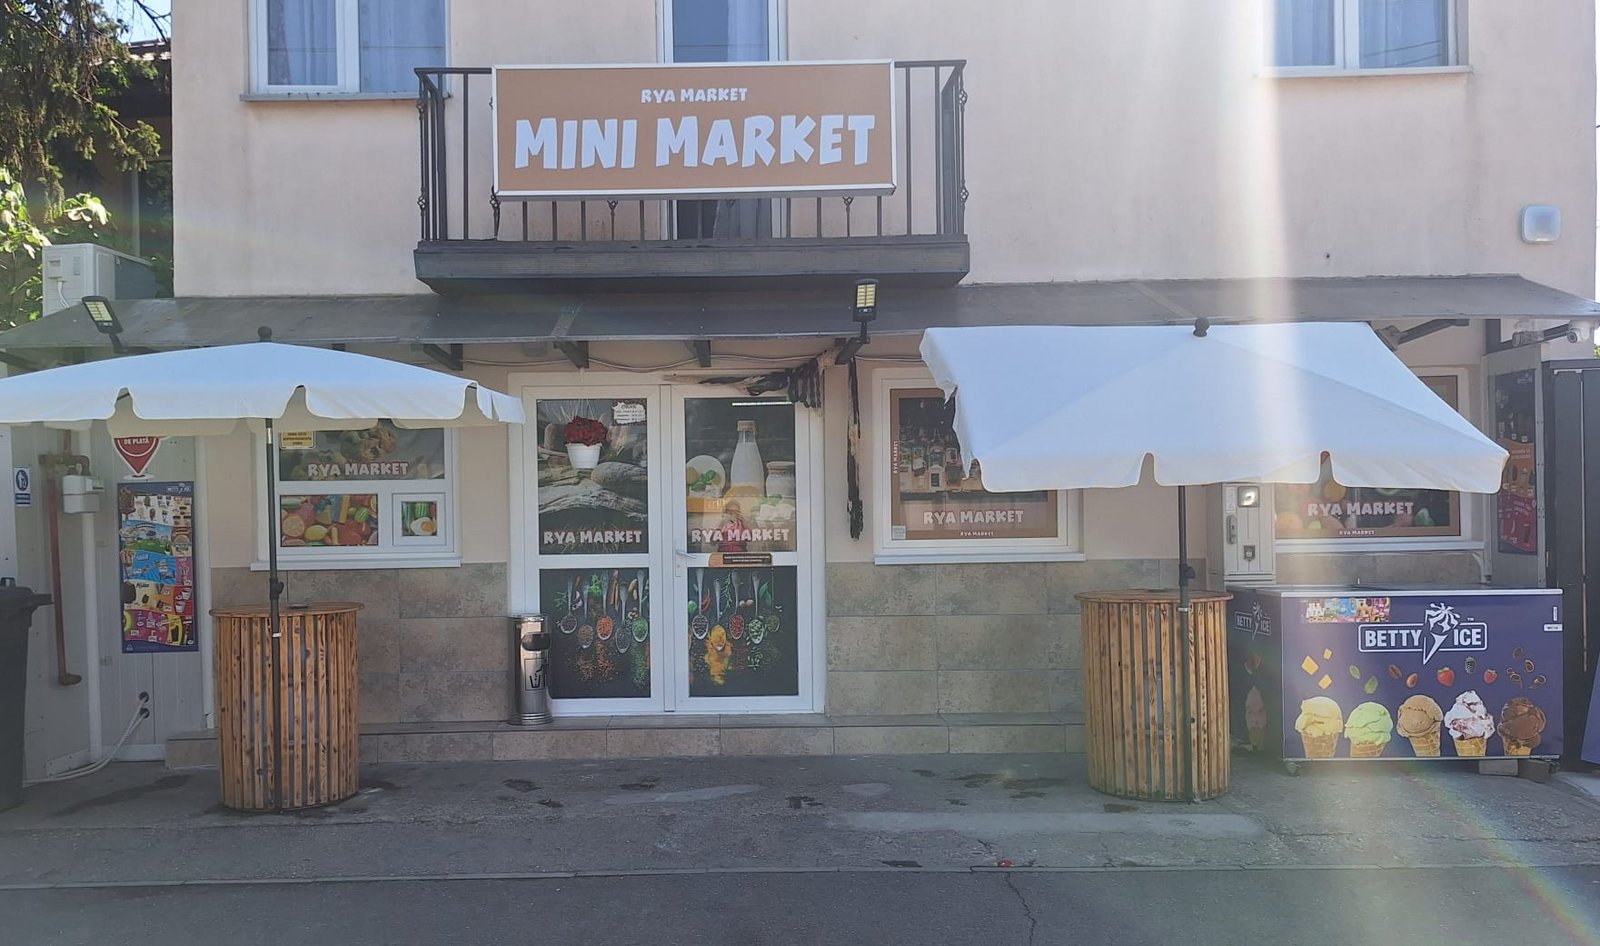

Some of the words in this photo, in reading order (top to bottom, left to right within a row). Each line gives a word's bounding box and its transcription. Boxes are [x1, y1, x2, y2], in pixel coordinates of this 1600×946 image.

[640, 89, 676, 104] RYA
[680, 87, 748, 103] MARKET
[514, 118, 638, 170] MINI
[655, 114, 876, 168] MARKET
[307, 463, 341, 477] RYA
[344, 462, 409, 476] MARKET
[1307, 503, 1343, 517] RYA
[1346, 502, 1414, 516] MARKET
[923, 511, 957, 525] RYA
[960, 510, 1024, 524] MARKET
[543, 531, 577, 545] RYA
[580, 530, 642, 544] MARKET
[691, 529, 724, 543] RYA
[727, 528, 790, 542] MARKET
[1365, 630, 1422, 647] BETTY
[1453, 628, 1482, 646] ICE
